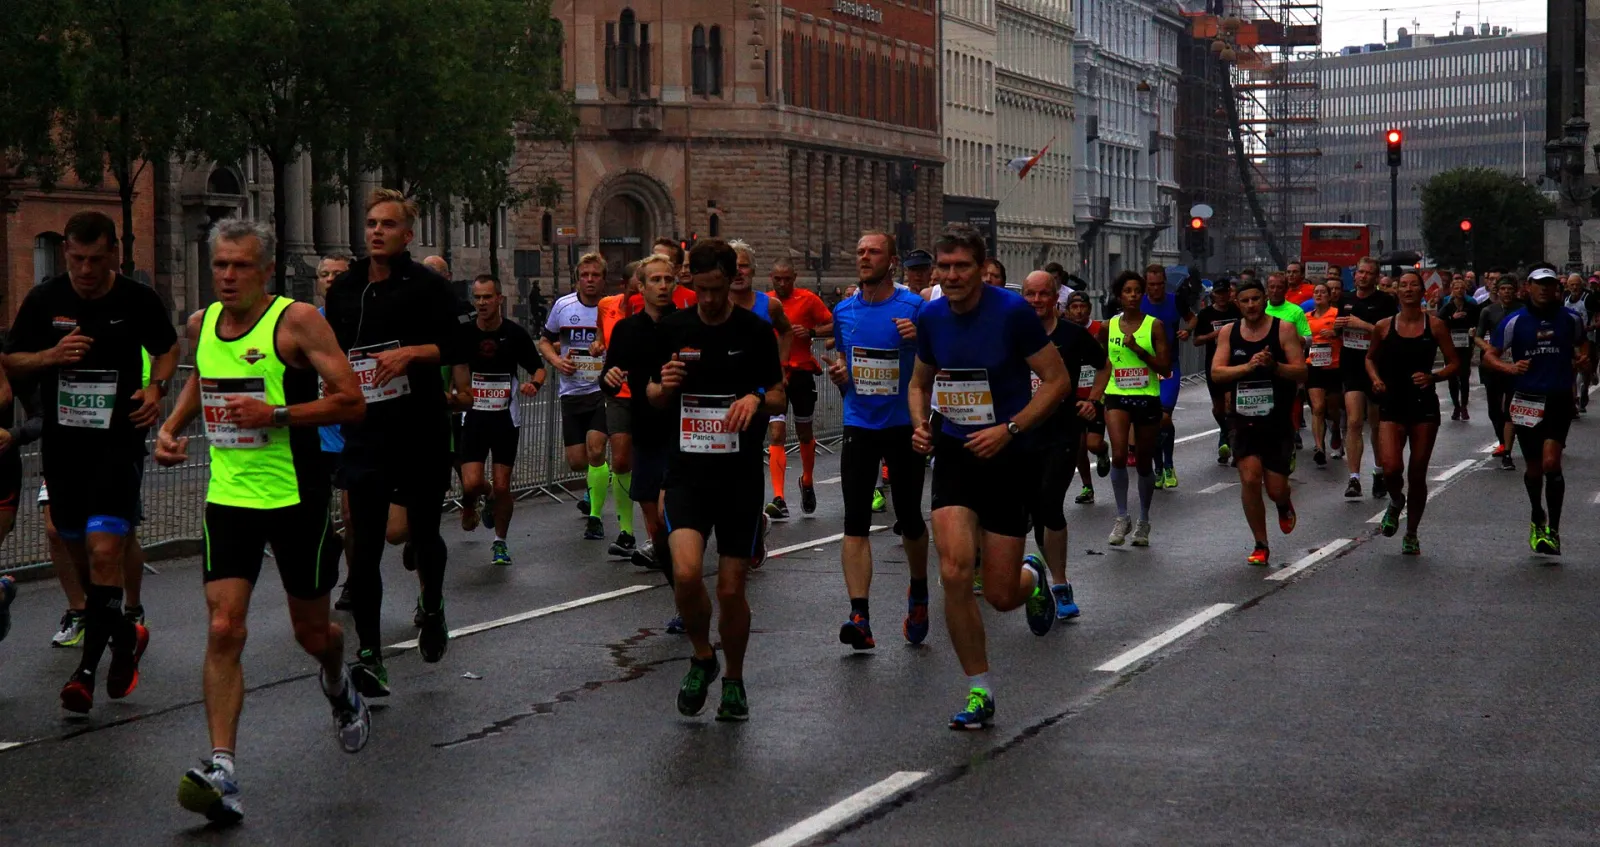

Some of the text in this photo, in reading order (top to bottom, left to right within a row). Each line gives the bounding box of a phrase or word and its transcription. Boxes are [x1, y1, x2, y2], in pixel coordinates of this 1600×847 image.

[836, 0, 884, 24] Danske Bank
[1524, 346, 1560, 356] AUSTRIA
[857, 367, 893, 380] 10185
[1118, 368, 1144, 377] 17909
[477, 389, 506, 398] 11309
[944, 392, 984, 405] 18167
[69, 395, 106, 408] 1216
[1242, 395, 1269, 405] 19025
[69, 408, 97, 416] Thomas
[1513, 405, 1539, 416] 20739
[690, 419, 730, 433] 1380
[692, 433, 715, 441] Patrick
